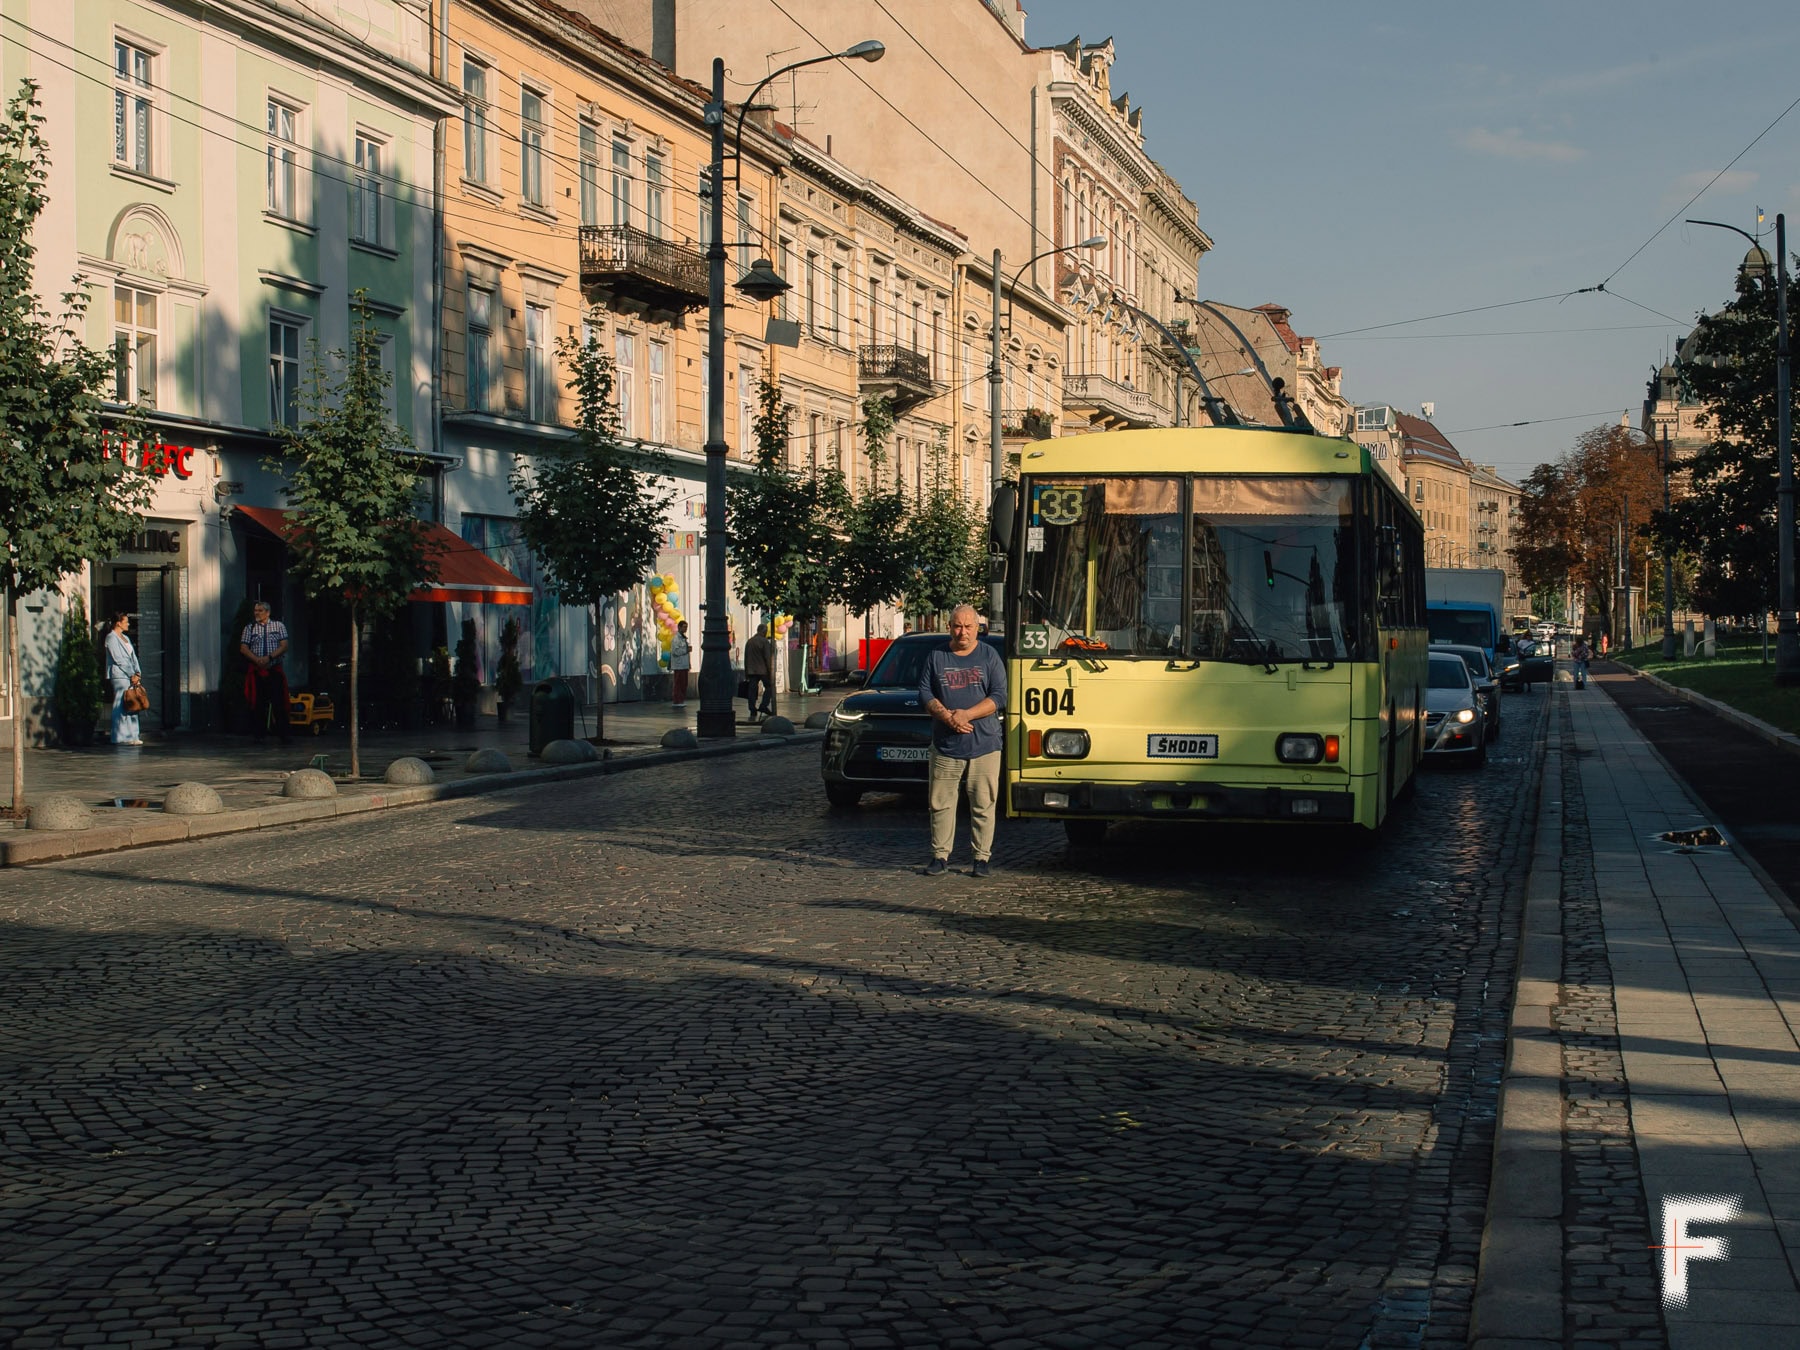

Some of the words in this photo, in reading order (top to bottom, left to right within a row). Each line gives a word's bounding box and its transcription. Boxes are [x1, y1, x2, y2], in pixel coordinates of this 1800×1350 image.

[138, 106, 146, 165] SCHOOL
[141, 443, 195, 477] KFC
[1040, 490, 1083, 520] 33
[1023, 631, 1048, 650] 33
[1025, 688, 1076, 716] 604
[882, 749, 896, 759] BC
[897, 749, 918, 759] 7920
[1158, 737, 1208, 754] ŠKODA
